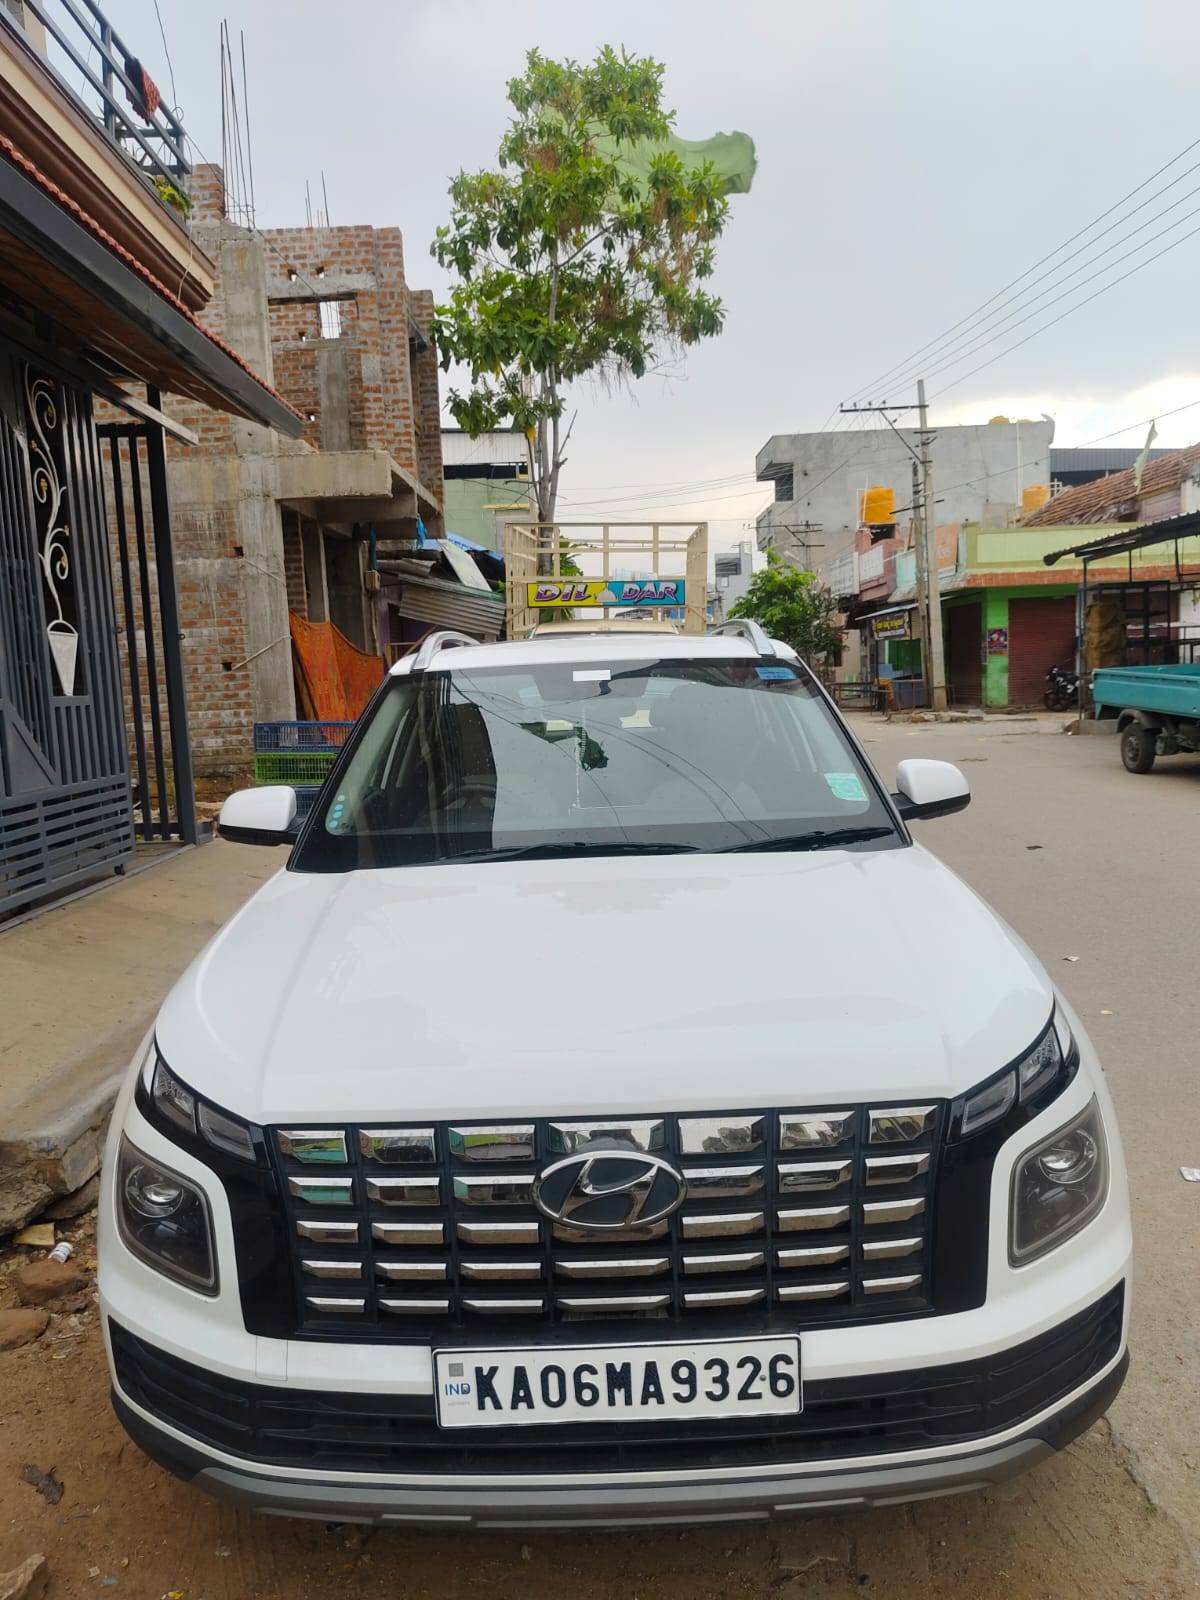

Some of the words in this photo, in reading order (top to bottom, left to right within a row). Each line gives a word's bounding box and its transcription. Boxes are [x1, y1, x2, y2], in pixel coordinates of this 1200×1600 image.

[535, 583, 591, 601] DIL
[622, 581, 678, 603] DAR
[445, 1383, 471, 1396] IND
[474, 1354, 795, 1411] KA06MA9326
